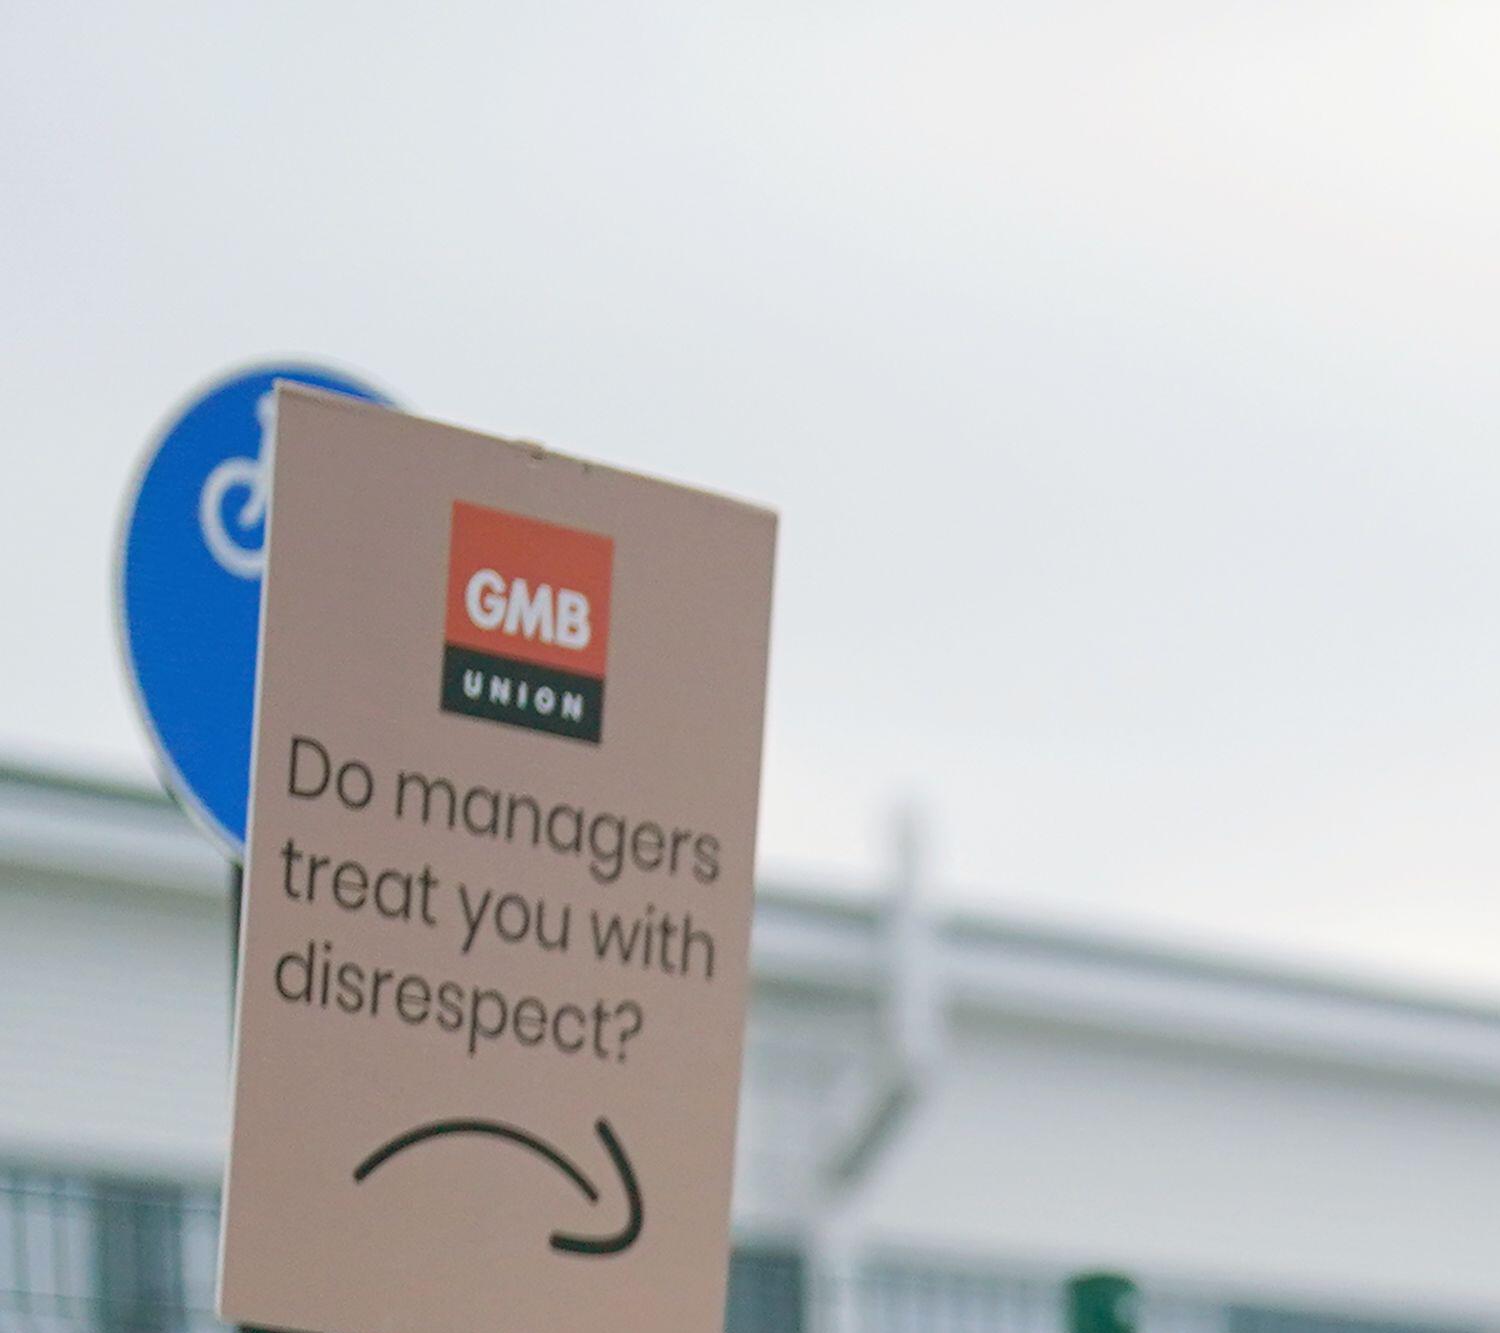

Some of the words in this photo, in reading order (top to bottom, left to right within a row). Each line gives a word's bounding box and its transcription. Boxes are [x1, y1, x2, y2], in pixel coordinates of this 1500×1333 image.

[465, 568, 591, 648] GMB
[462, 670, 584, 719] UNION
[287, 735, 374, 810] Do
[398, 766, 722, 883] managers
[282, 840, 438, 926] treat
[456, 876, 571, 953] you
[588, 900, 716, 980] with
[274, 943, 644, 1062] disrespect?
